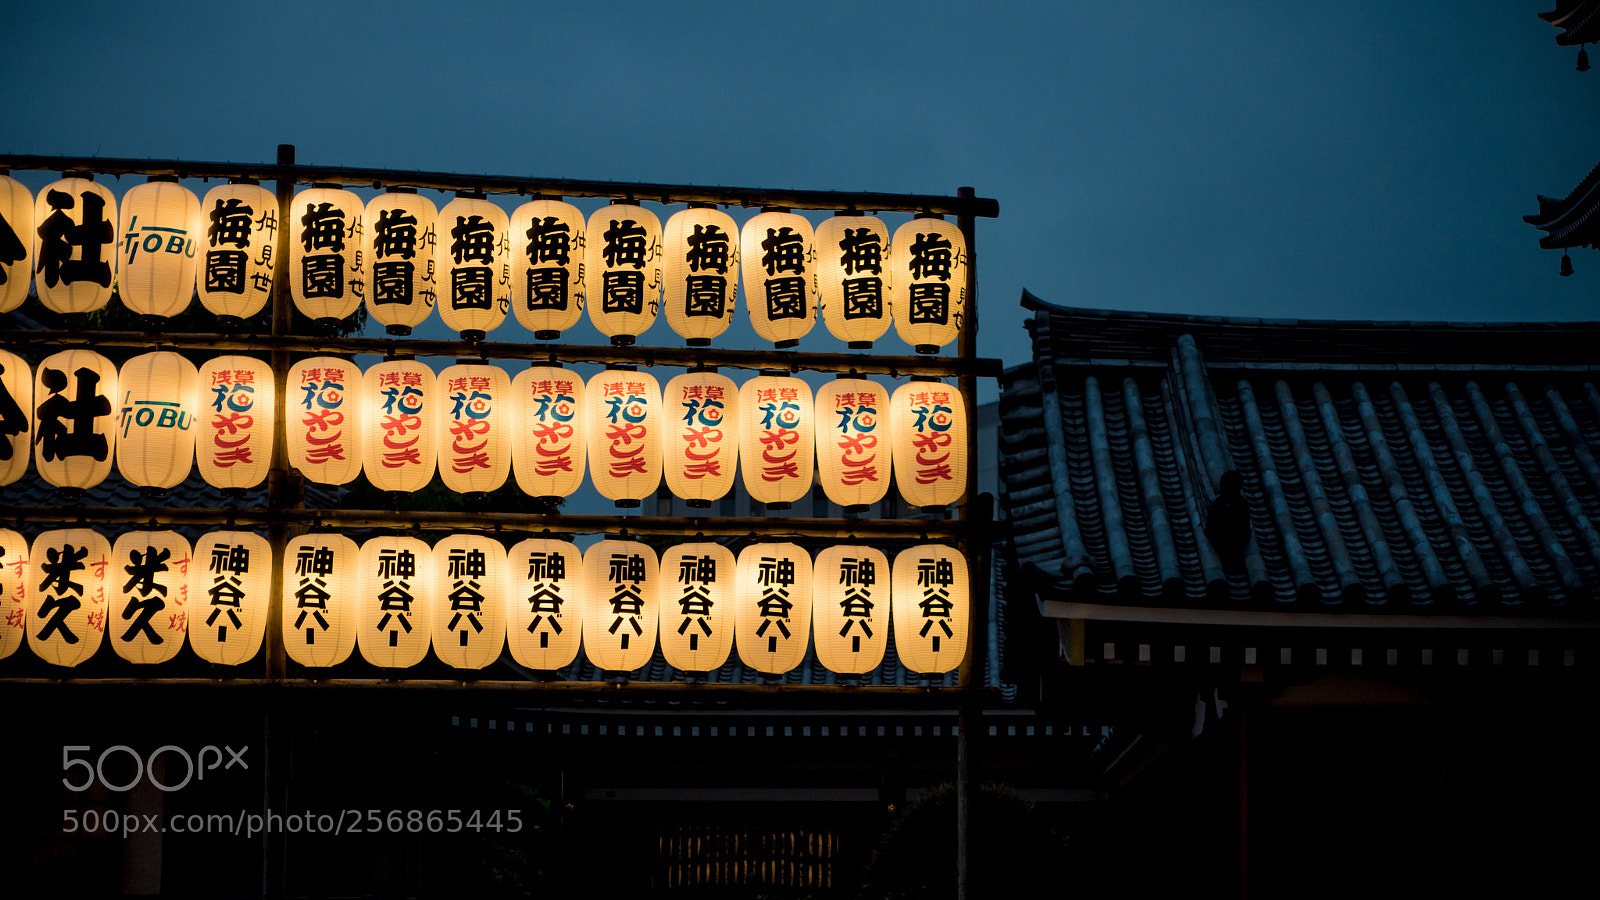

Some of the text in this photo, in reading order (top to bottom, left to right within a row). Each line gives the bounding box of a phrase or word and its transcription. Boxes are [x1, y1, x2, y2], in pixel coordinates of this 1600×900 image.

[36, 188, 115, 288] 社
[205, 197, 253, 294] 梅園
[301, 203, 345, 299] 梅園
[373, 209, 417, 305] 梅園
[451, 216, 495, 310] 梅園
[526, 217, 570, 311] 梅園
[603, 220, 647, 314] 梅園
[686, 224, 730, 319] 梅園
[762, 227, 806, 321] 梅園
[839, 228, 882, 320] 梅園
[909, 233, 953, 325] 梅園
[35, 365, 112, 462] 社
[212, 370, 255, 386] 浅草
[302, 368, 345, 384] 浅草
[379, 372, 422, 387] 浅草
[449, 377, 490, 393] 浅草
[532, 380, 574, 395] 浅草
[604, 382, 646, 397] 浅草
[683, 385, 724, 401] 浅草
[757, 388, 798, 403] 浅草
[835, 392, 876, 408] 浅草
[910, 392, 950, 406] 浅草
[36, 544, 89, 644] 米久
[121, 546, 171, 645] 米久
[206, 544, 249, 642] 神谷バー
[295, 546, 333, 644] 神谷バー
[377, 550, 414, 646] 神谷バー
[448, 549, 485, 646] 神谷バー
[528, 552, 565, 648] 神谷バー
[609, 554, 645, 649] 神谷バー
[678, 555, 715, 650] 神谷バー
[756, 557, 794, 652] 神谷バー
[839, 558, 875, 652] 神谷バー
[918, 558, 953, 652] 神谷バー
